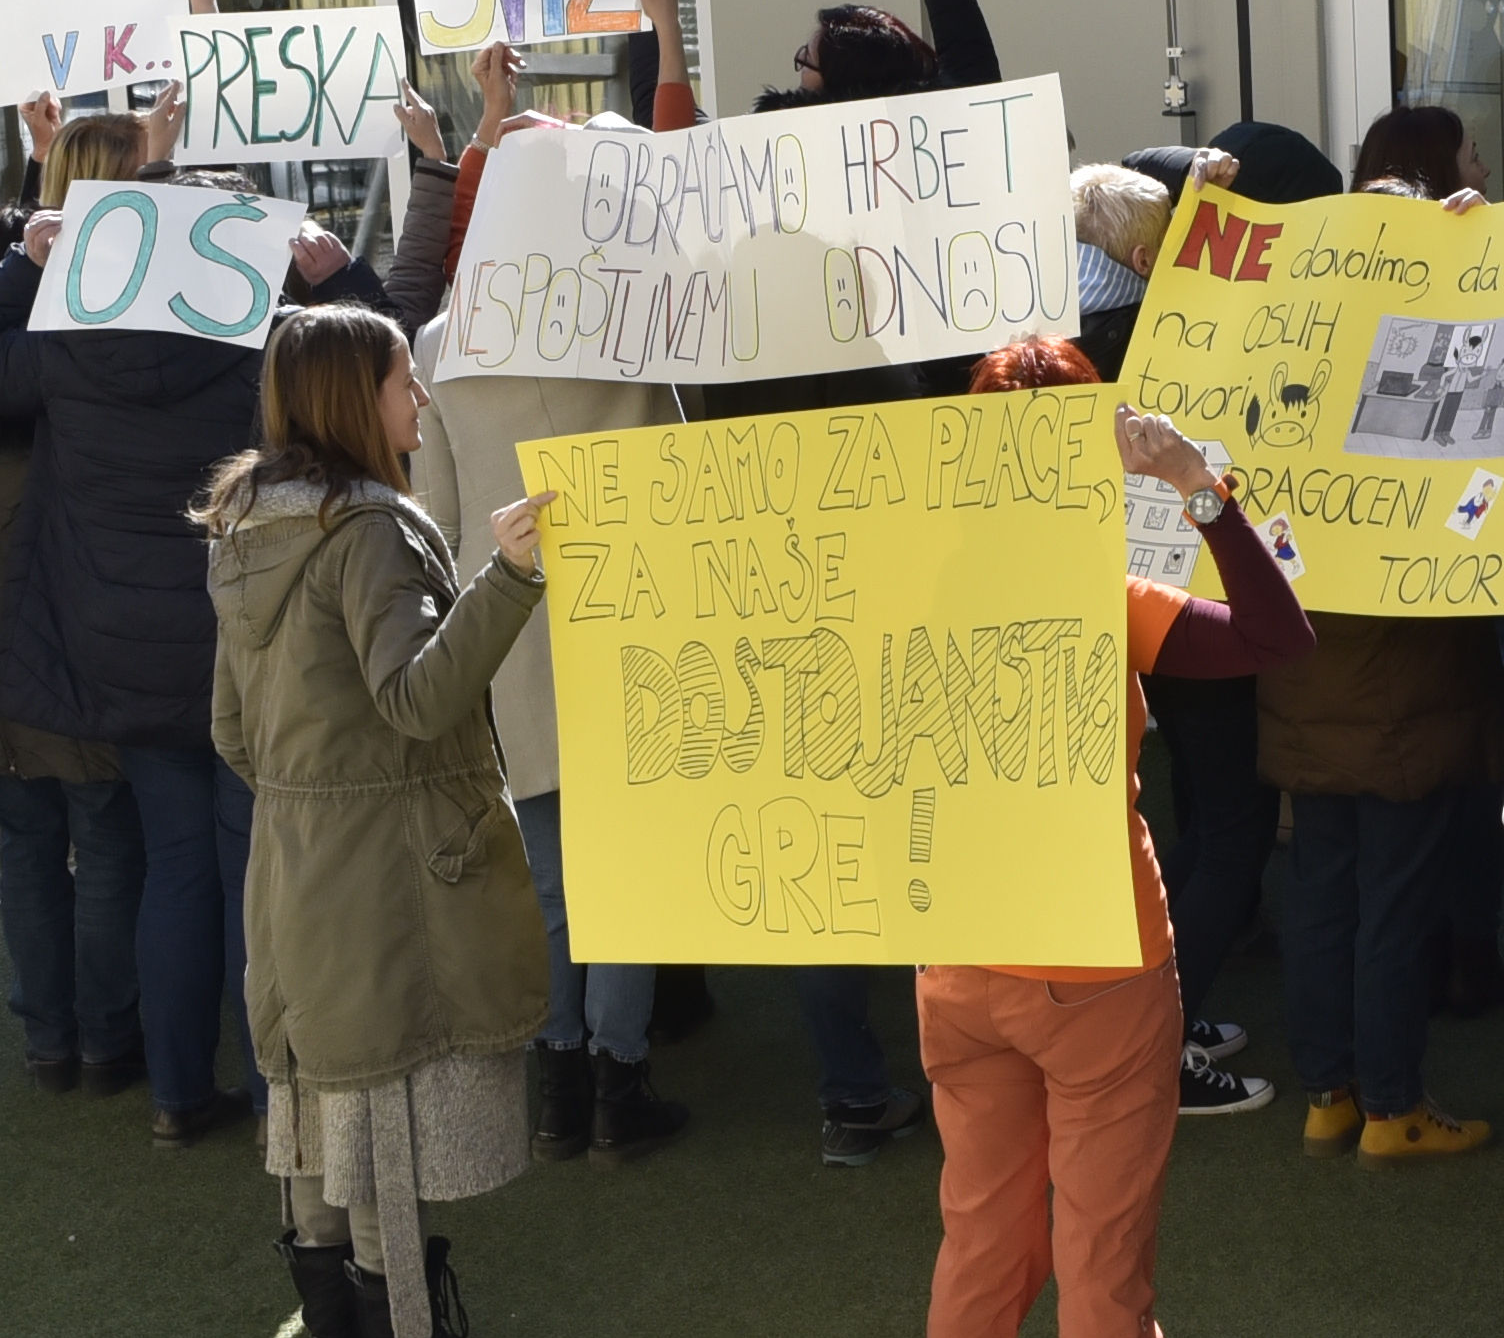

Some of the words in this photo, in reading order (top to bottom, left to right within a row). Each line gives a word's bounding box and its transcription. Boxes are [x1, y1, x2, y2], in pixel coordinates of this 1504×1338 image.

[42, 31, 79, 90] V
[180, 24, 406, 149] PRESKA
[582, 132, 808, 255] OBRAČAMO
[842, 93, 1033, 216] HRBET
[65, 189, 271, 337] OŠ
[824, 214, 1071, 344] ODNOSU
[1172, 201, 1284, 284] NE
[1290, 217, 1431, 303] dovolimo,
[1458, 237, 1500, 293] da
[1152, 310, 1214, 352] na
[1242, 301, 1343, 354] OSLIH
[1138, 362, 1253, 422] tovori
[538, 440, 628, 527] NE
[649, 422, 801, 525] SAMO
[817, 413, 906, 513] ZA
[926, 388, 1118, 525] PLAČE,
[1231, 465, 1432, 531] DRAGOCENI
[559, 543, 666, 622] ZA
[692, 518, 856, 624] NAŠE
[1379, 553, 1504, 607] TOVOR
[620, 618, 1120, 798] DOSTOJANSTVO
[706, 796, 881, 937] GRE
